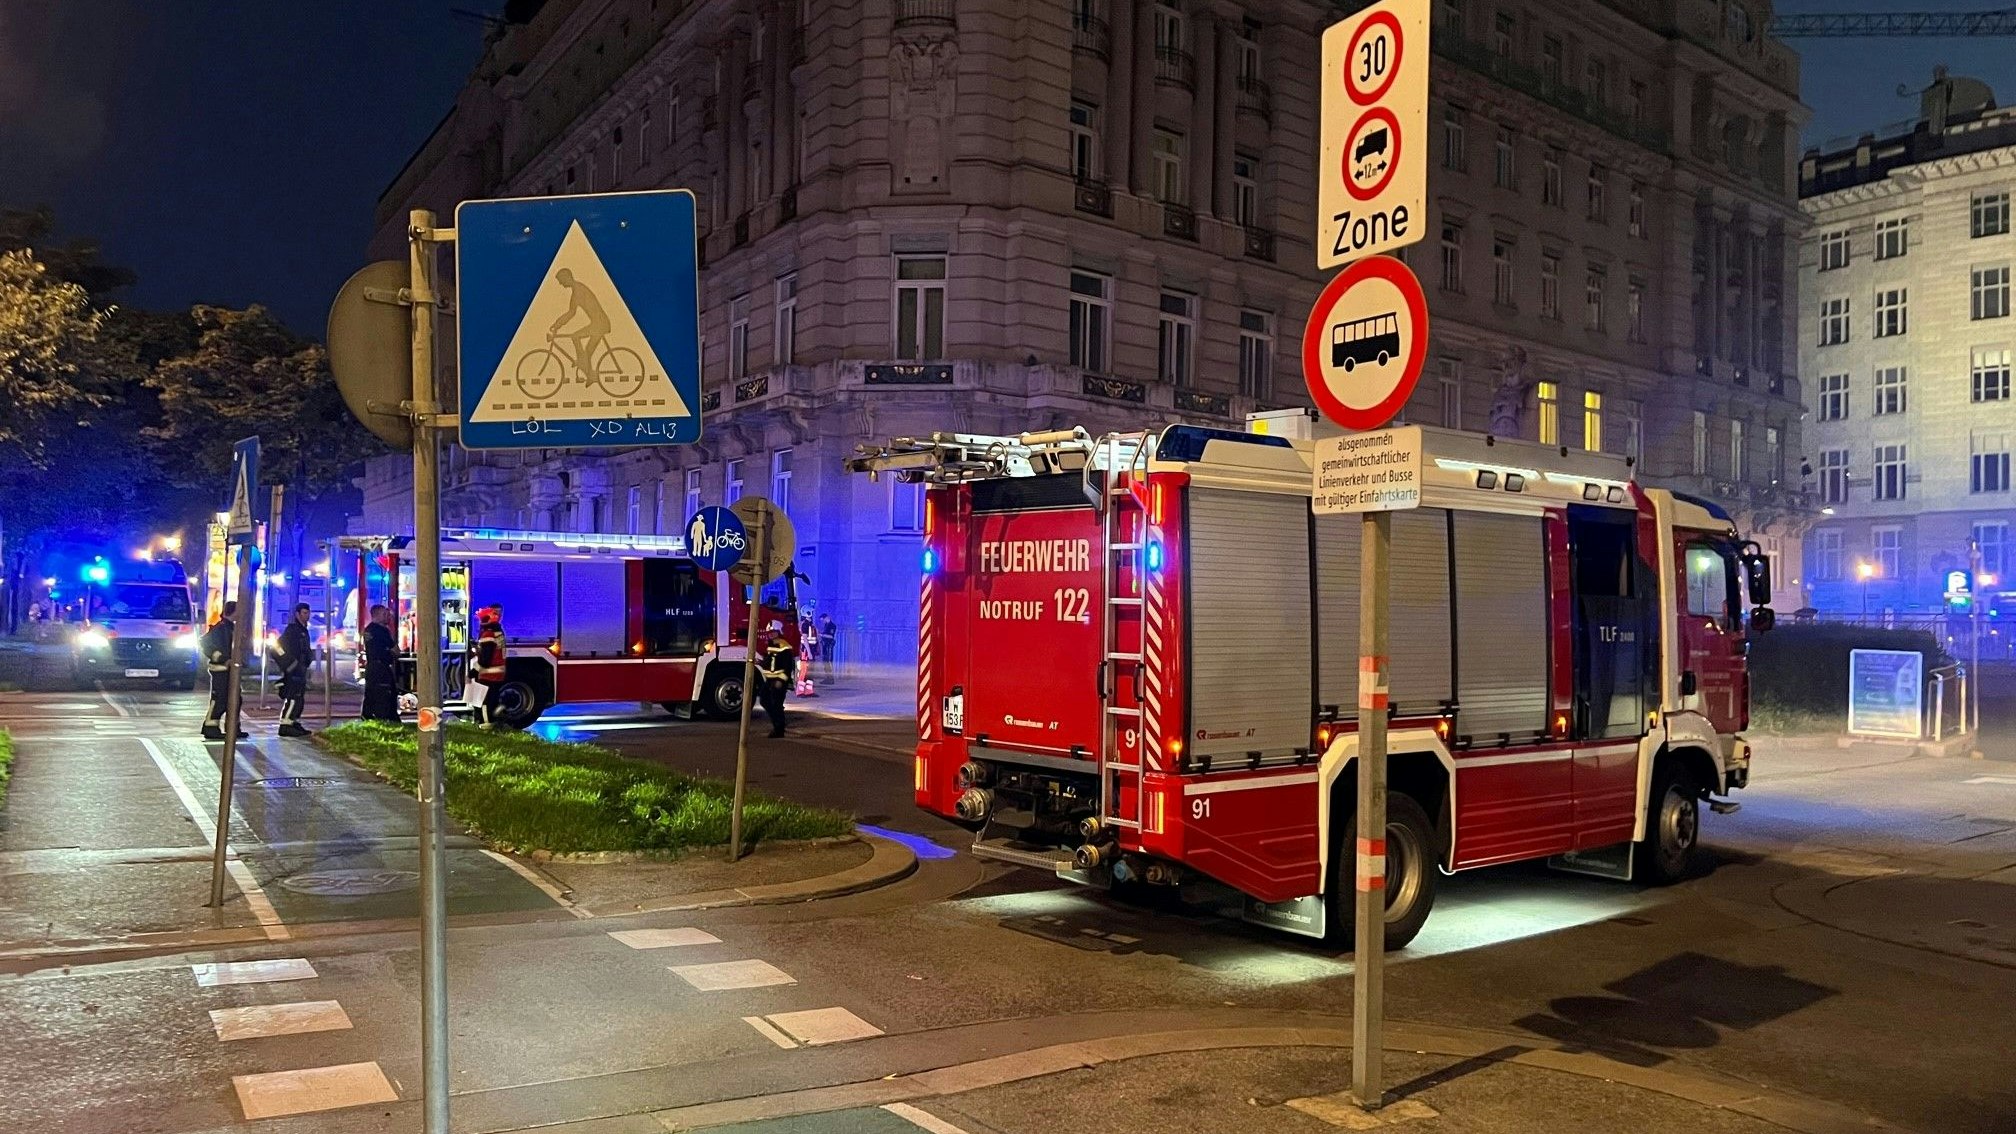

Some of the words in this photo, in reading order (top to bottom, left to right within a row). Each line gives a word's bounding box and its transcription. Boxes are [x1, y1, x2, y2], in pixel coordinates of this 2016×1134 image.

[1360, 35, 1386, 82] 30
[1364, 162, 1378, 180] 12m
[1333, 204, 1409, 256] Zone
[512, 419, 562, 434] LOL
[589, 420, 623, 438] XD
[1338, 433, 1393, 452] ausgenommen
[1321, 451, 1410, 473] gemeinwirtschaftlicher
[1319, 472, 1370, 489] Linienverkehr
[1372, 470, 1386, 484] und
[1389, 469, 1413, 482] Busse
[1314, 493, 1327, 507] mit
[1328, 491, 1357, 509] gültiger
[1359, 488, 1418, 504] Einfahrtskarte
[981, 540, 1089, 572] FEUERWEHR
[665, 608, 680, 616] HLF
[980, 600, 1044, 621] NOTRUF
[1054, 588, 1089, 621] 122
[1600, 626, 1617, 642] TLF
[1192, 798, 1210, 819] 91
